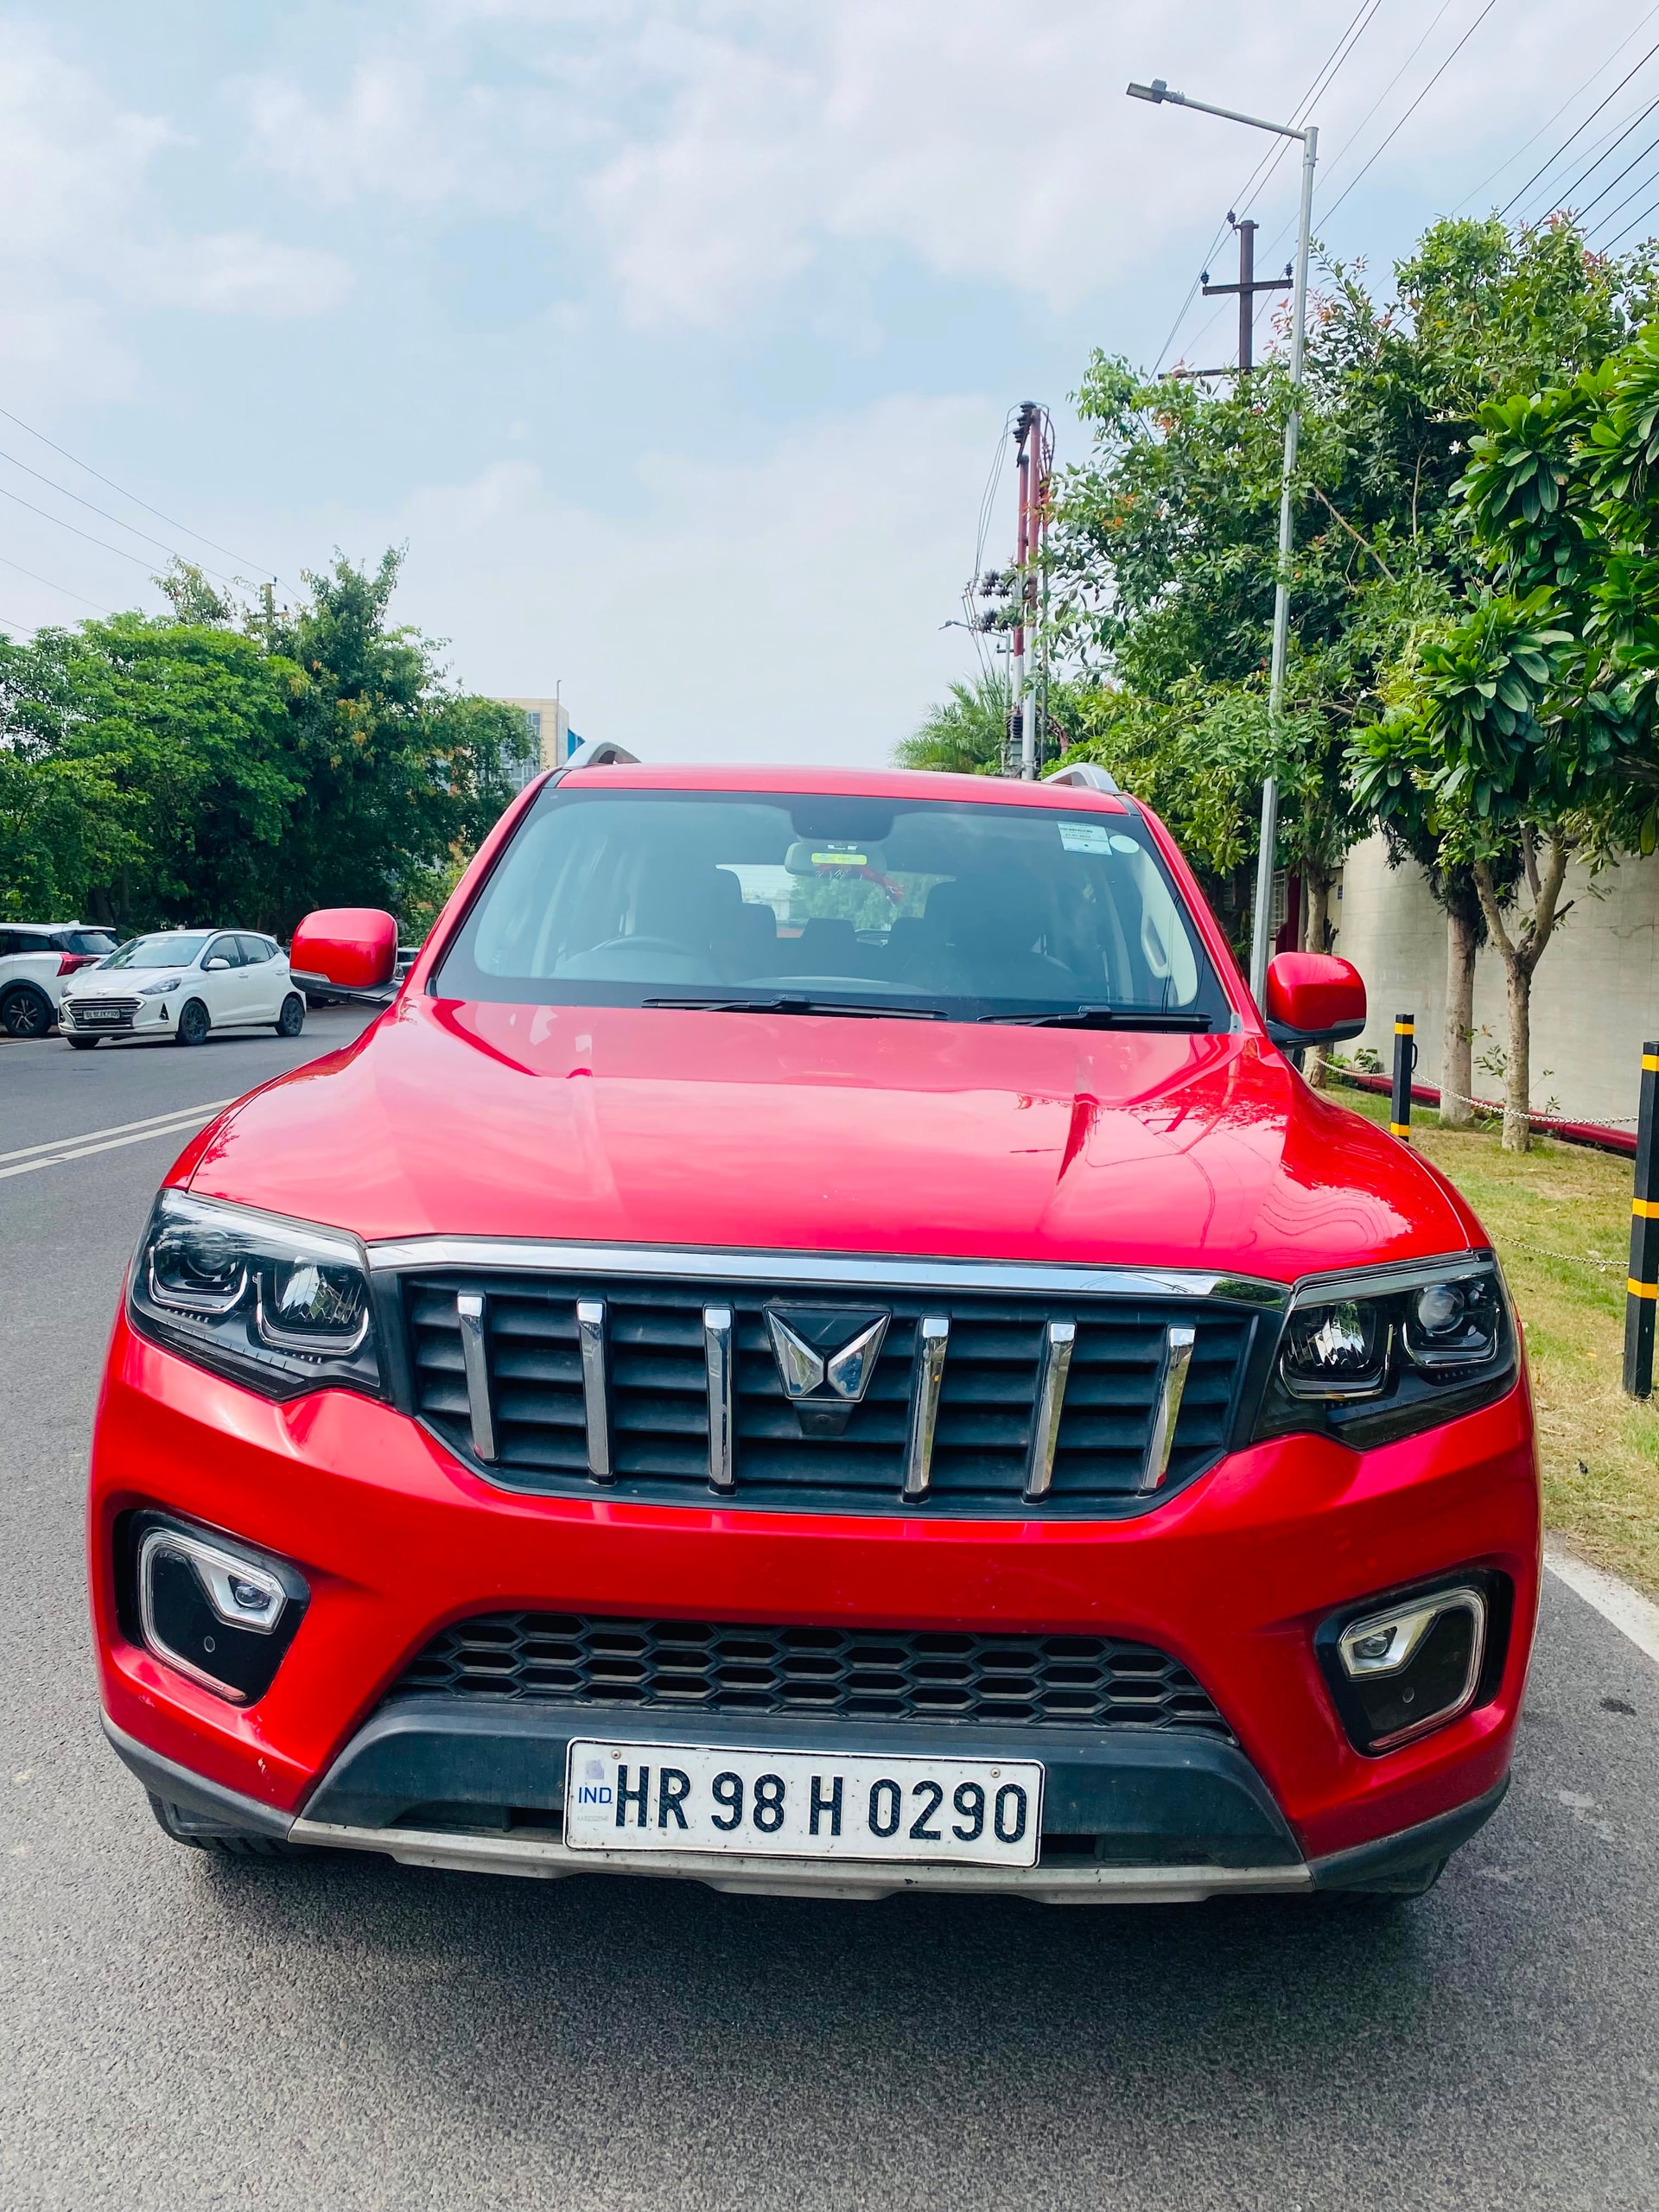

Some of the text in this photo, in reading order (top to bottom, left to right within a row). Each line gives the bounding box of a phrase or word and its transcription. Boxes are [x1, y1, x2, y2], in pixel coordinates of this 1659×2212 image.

[579, 1787, 612, 1804] IND
[616, 1765, 1027, 1843] HR 98 H 0290
